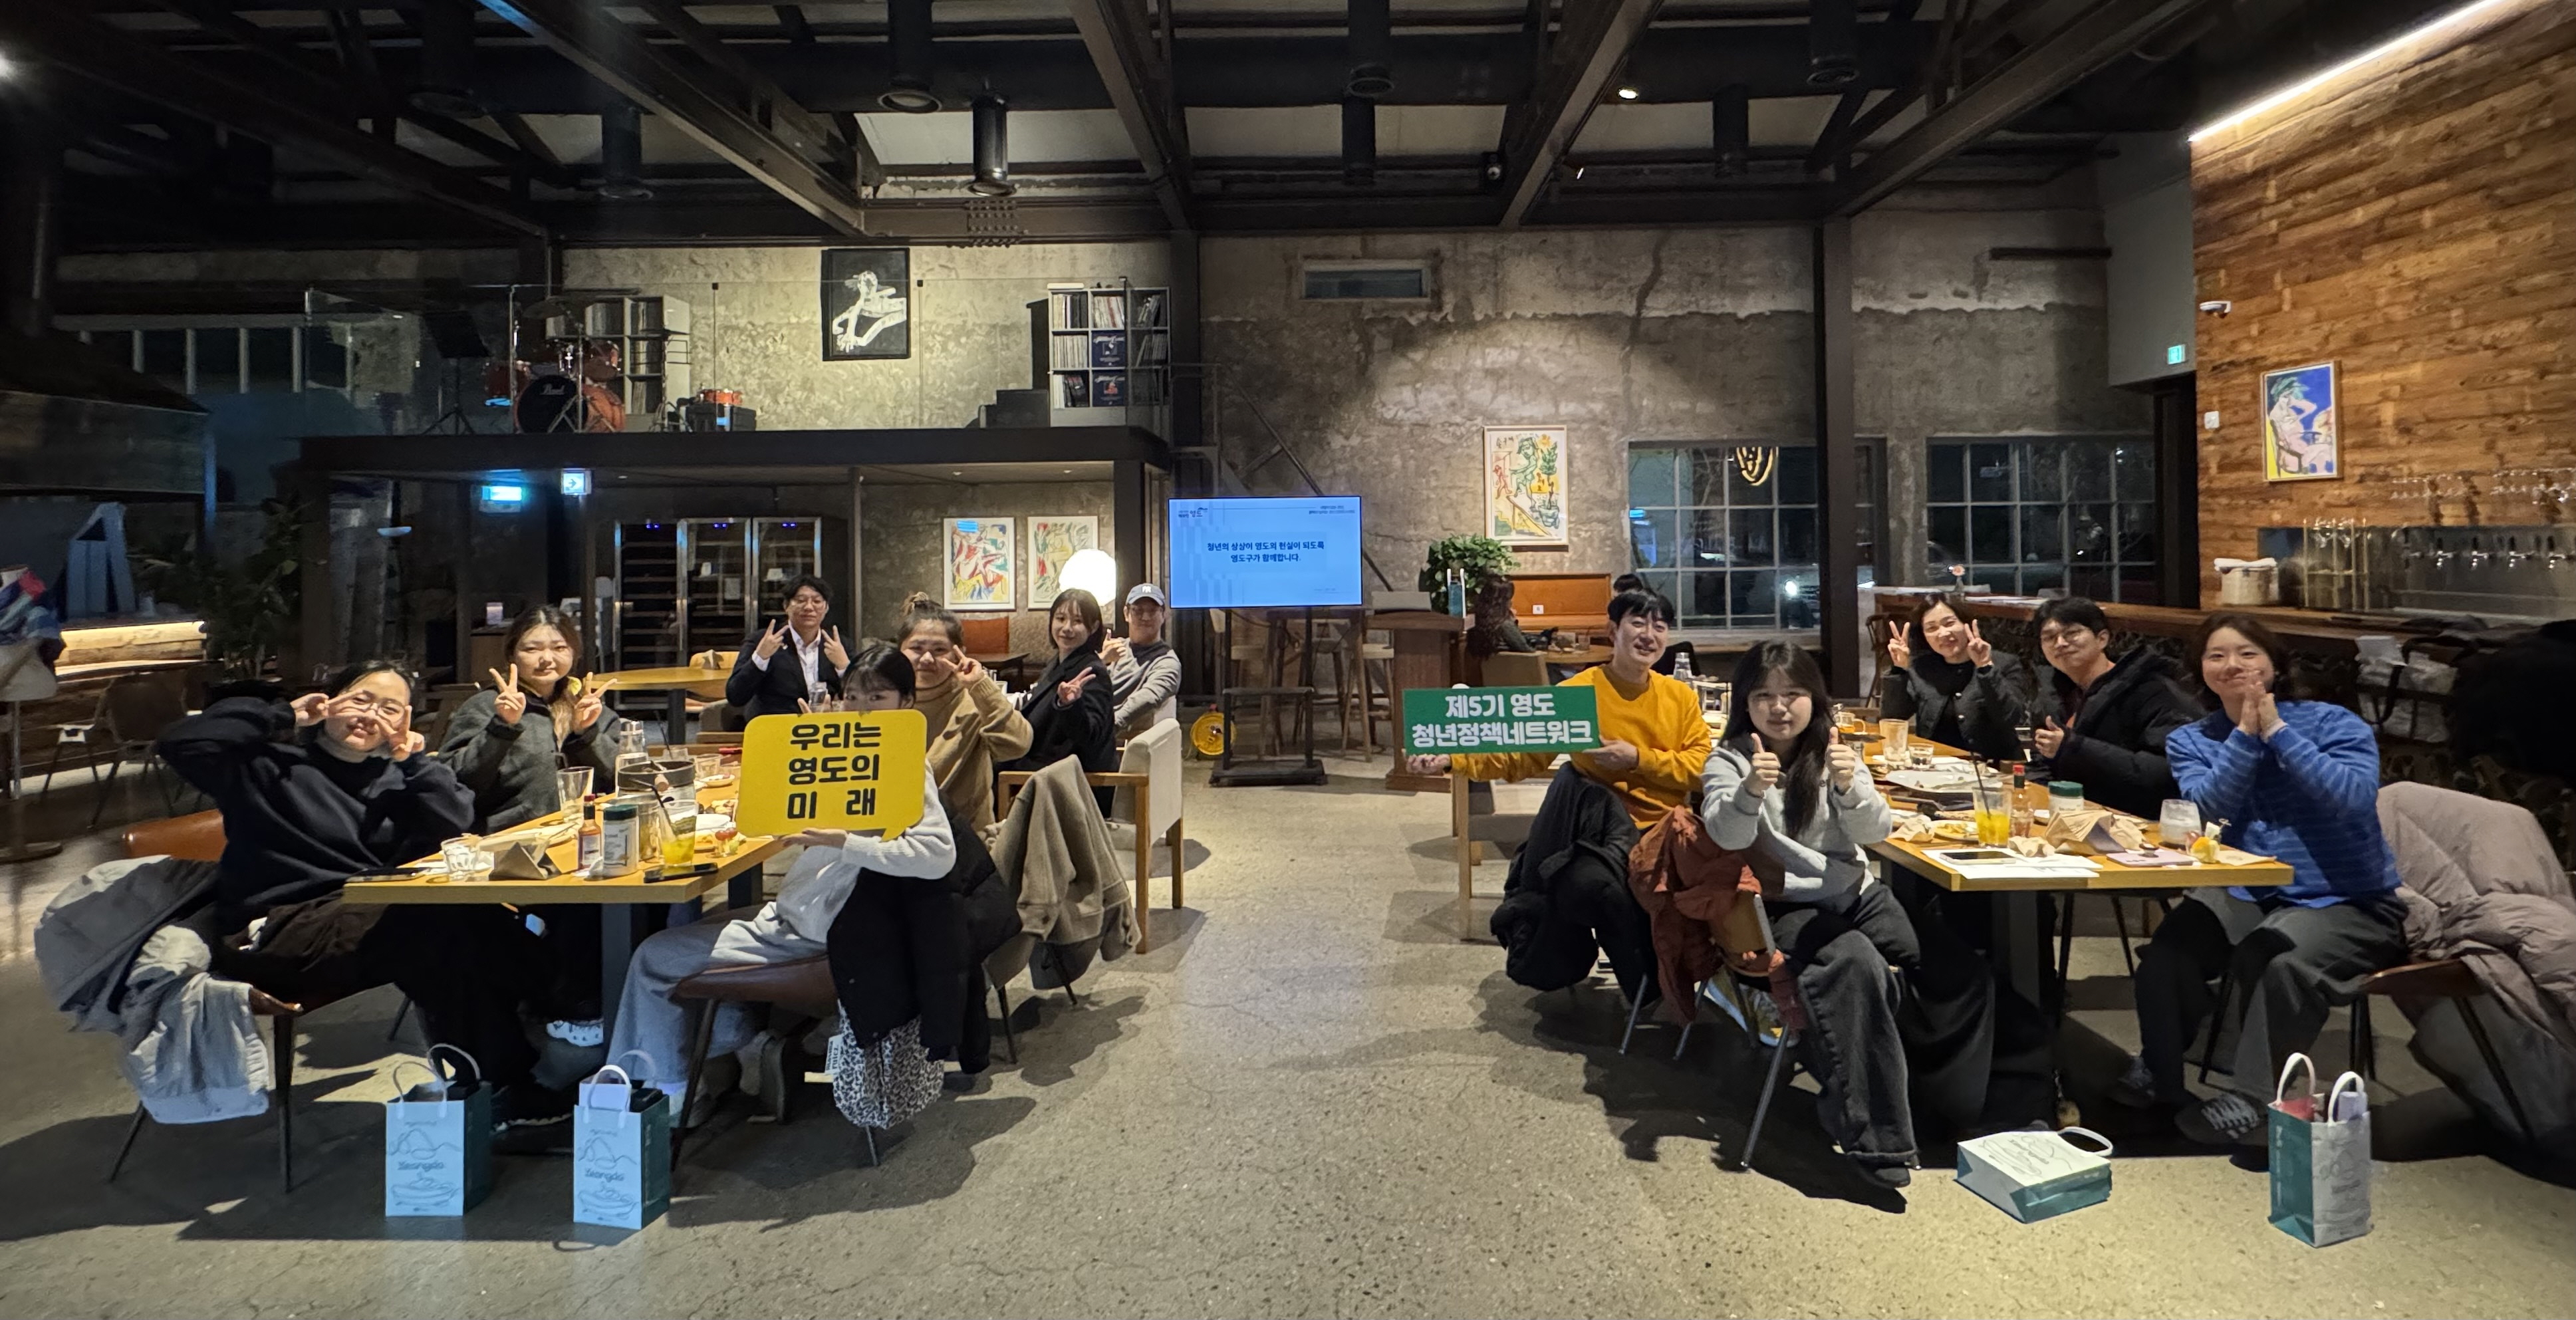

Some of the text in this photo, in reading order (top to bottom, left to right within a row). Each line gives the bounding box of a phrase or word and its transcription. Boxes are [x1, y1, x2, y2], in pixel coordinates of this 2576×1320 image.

[1207, 541, 1325, 551] 청년의 상상이 영도의 현실이 되도록
[1230, 553, 1261, 563] 영도구가
[1444, 692, 1557, 718] 제5기 영도
[790, 722, 882, 751] 우리는
[1412, 720, 1595, 748] 청년정책네트워크
[788, 753, 880, 785] 영도의
[787, 787, 876, 819] 미 래
